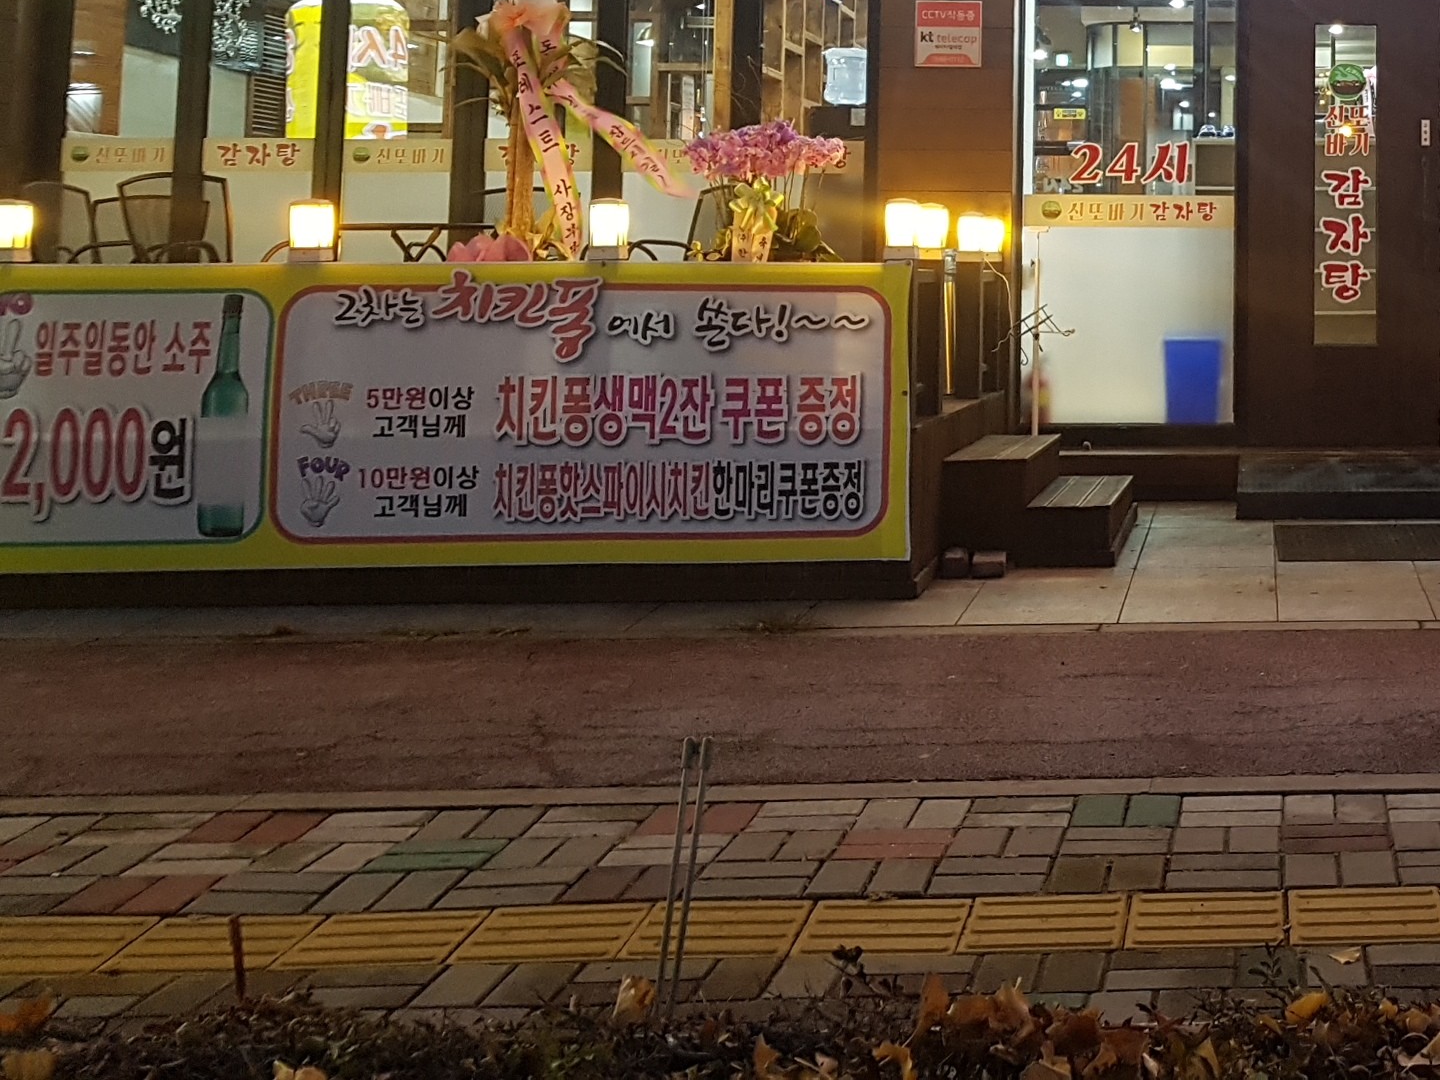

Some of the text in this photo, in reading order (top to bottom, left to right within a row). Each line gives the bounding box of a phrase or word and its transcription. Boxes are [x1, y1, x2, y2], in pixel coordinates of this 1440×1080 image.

[920, 31, 934, 43] kt
[217, 142, 300, 167] 감자탕
[376, 145, 446, 165] 신또바기
[1070, 140, 1189, 185] 24시
[1150, 201, 1217, 222] 감자탕
[35, 320, 212, 377] 일주일동안 소주
[366, 386, 475, 410] 5만원이상
[721, 376, 785, 441] 쿠폰
[797, 375, 858, 442] 증정
[372, 414, 467, 438] 고객님께
[2, 407, 192, 522] 2,000원
[297, 456, 350, 482] FOUR
[358, 466, 479, 490] 10만원이상
[373, 494, 468, 518] 고객님께
